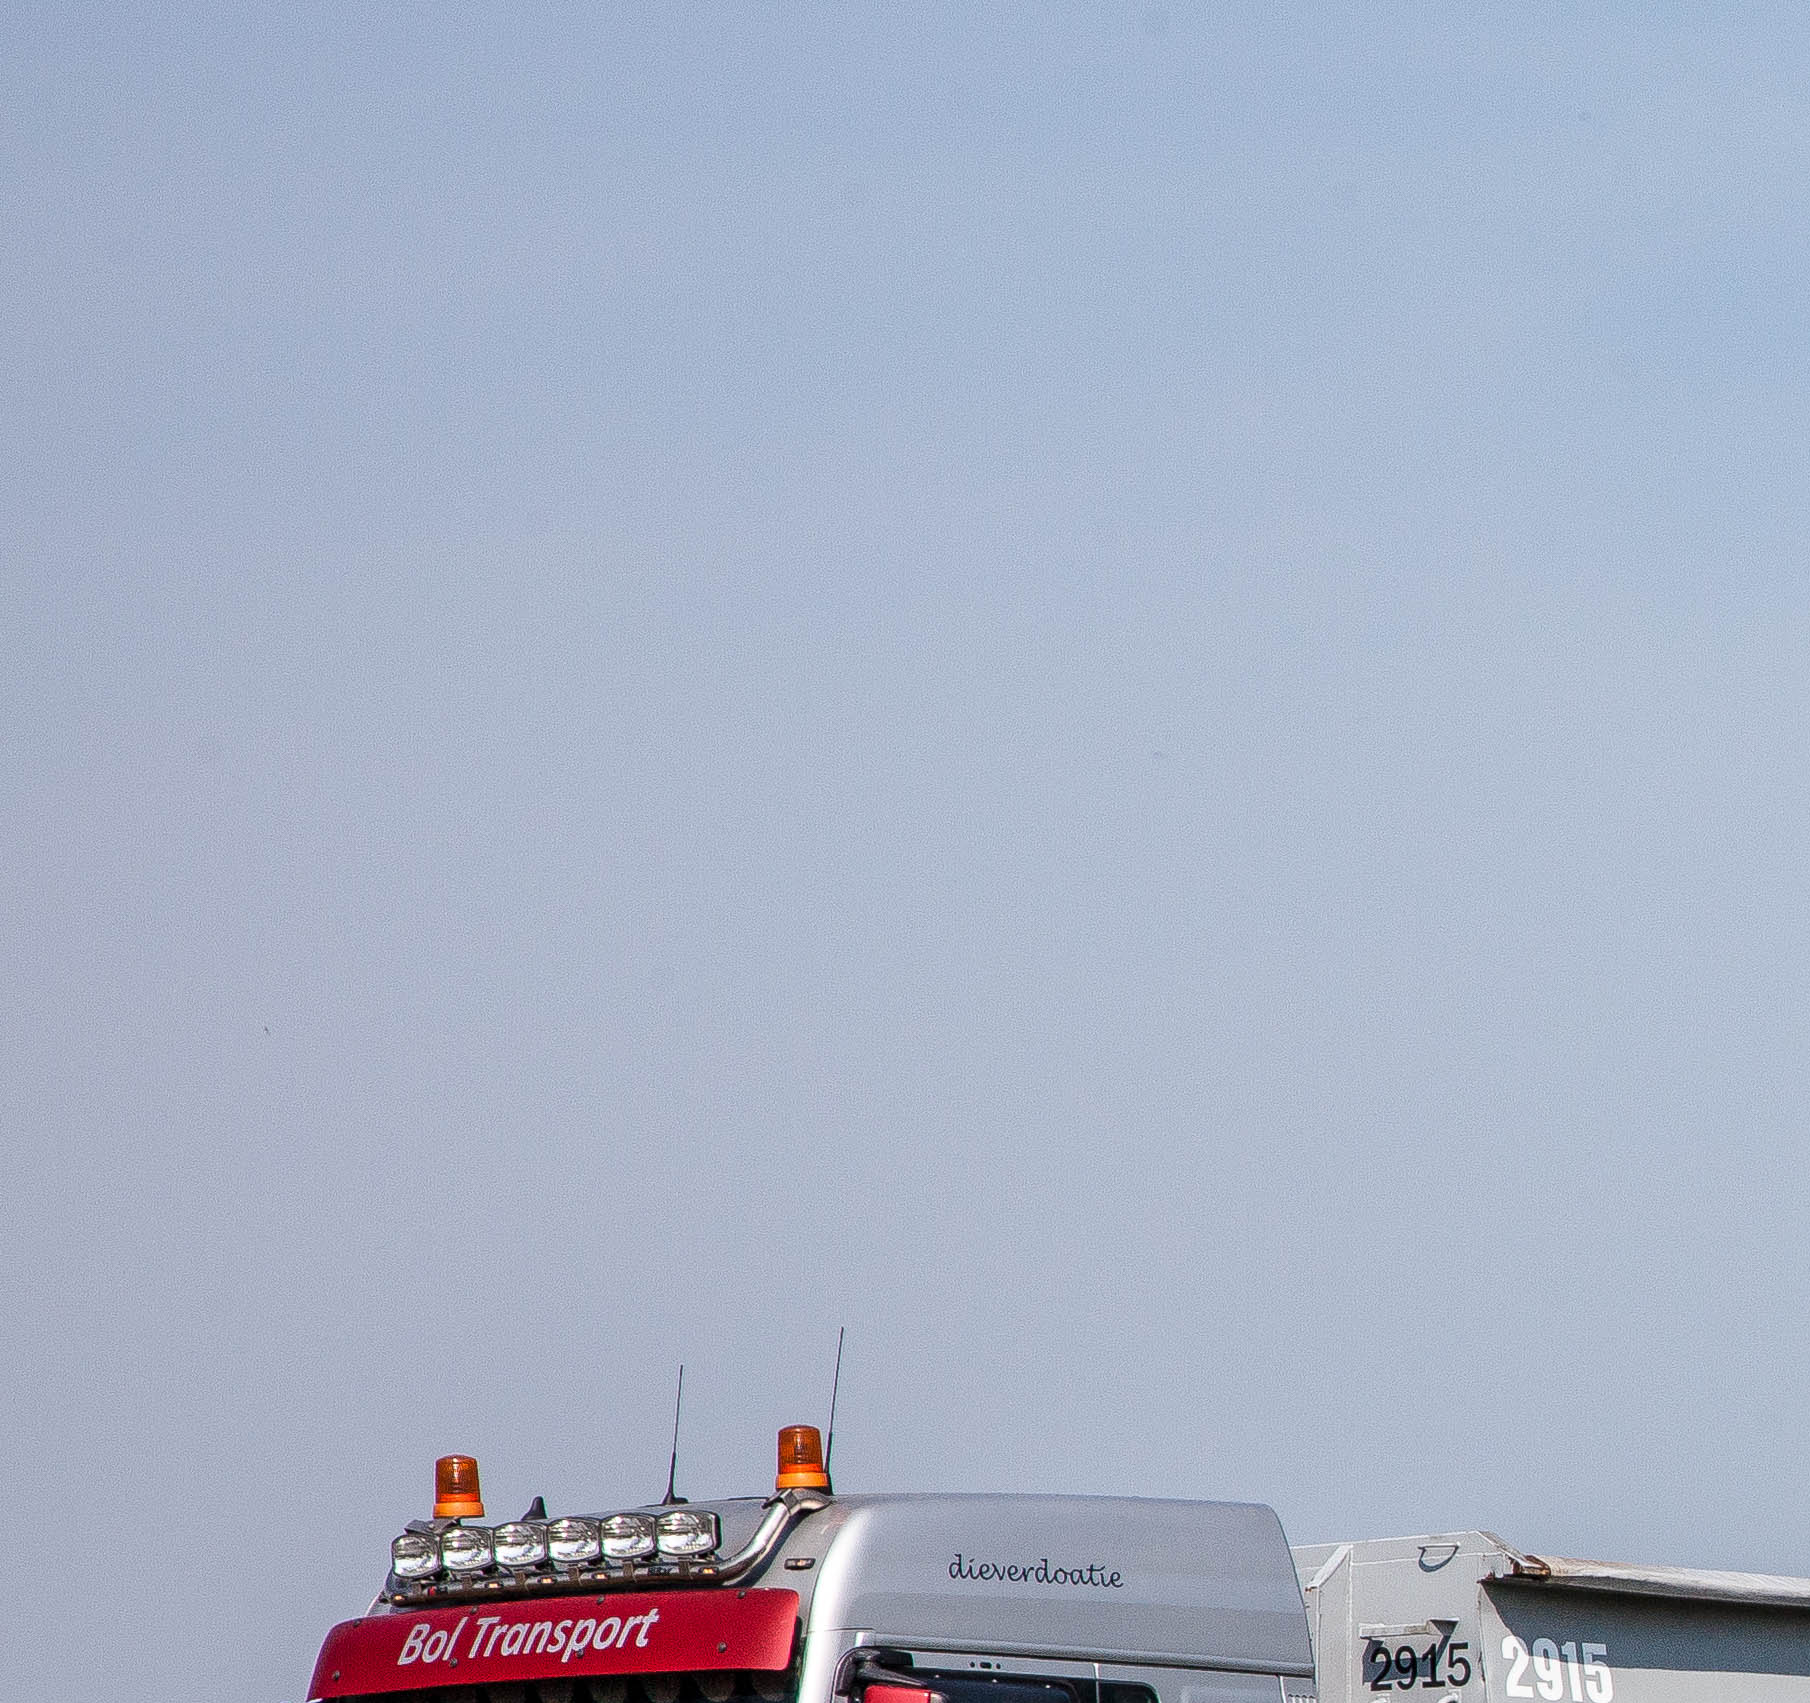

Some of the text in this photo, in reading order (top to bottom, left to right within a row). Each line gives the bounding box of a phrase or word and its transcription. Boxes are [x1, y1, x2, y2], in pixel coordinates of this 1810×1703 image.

[947, 1553, 1124, 1588] dieverdoatie
[397, 1608, 660, 1666] Bol Transport
[1370, 1641, 1472, 1692] 2915
